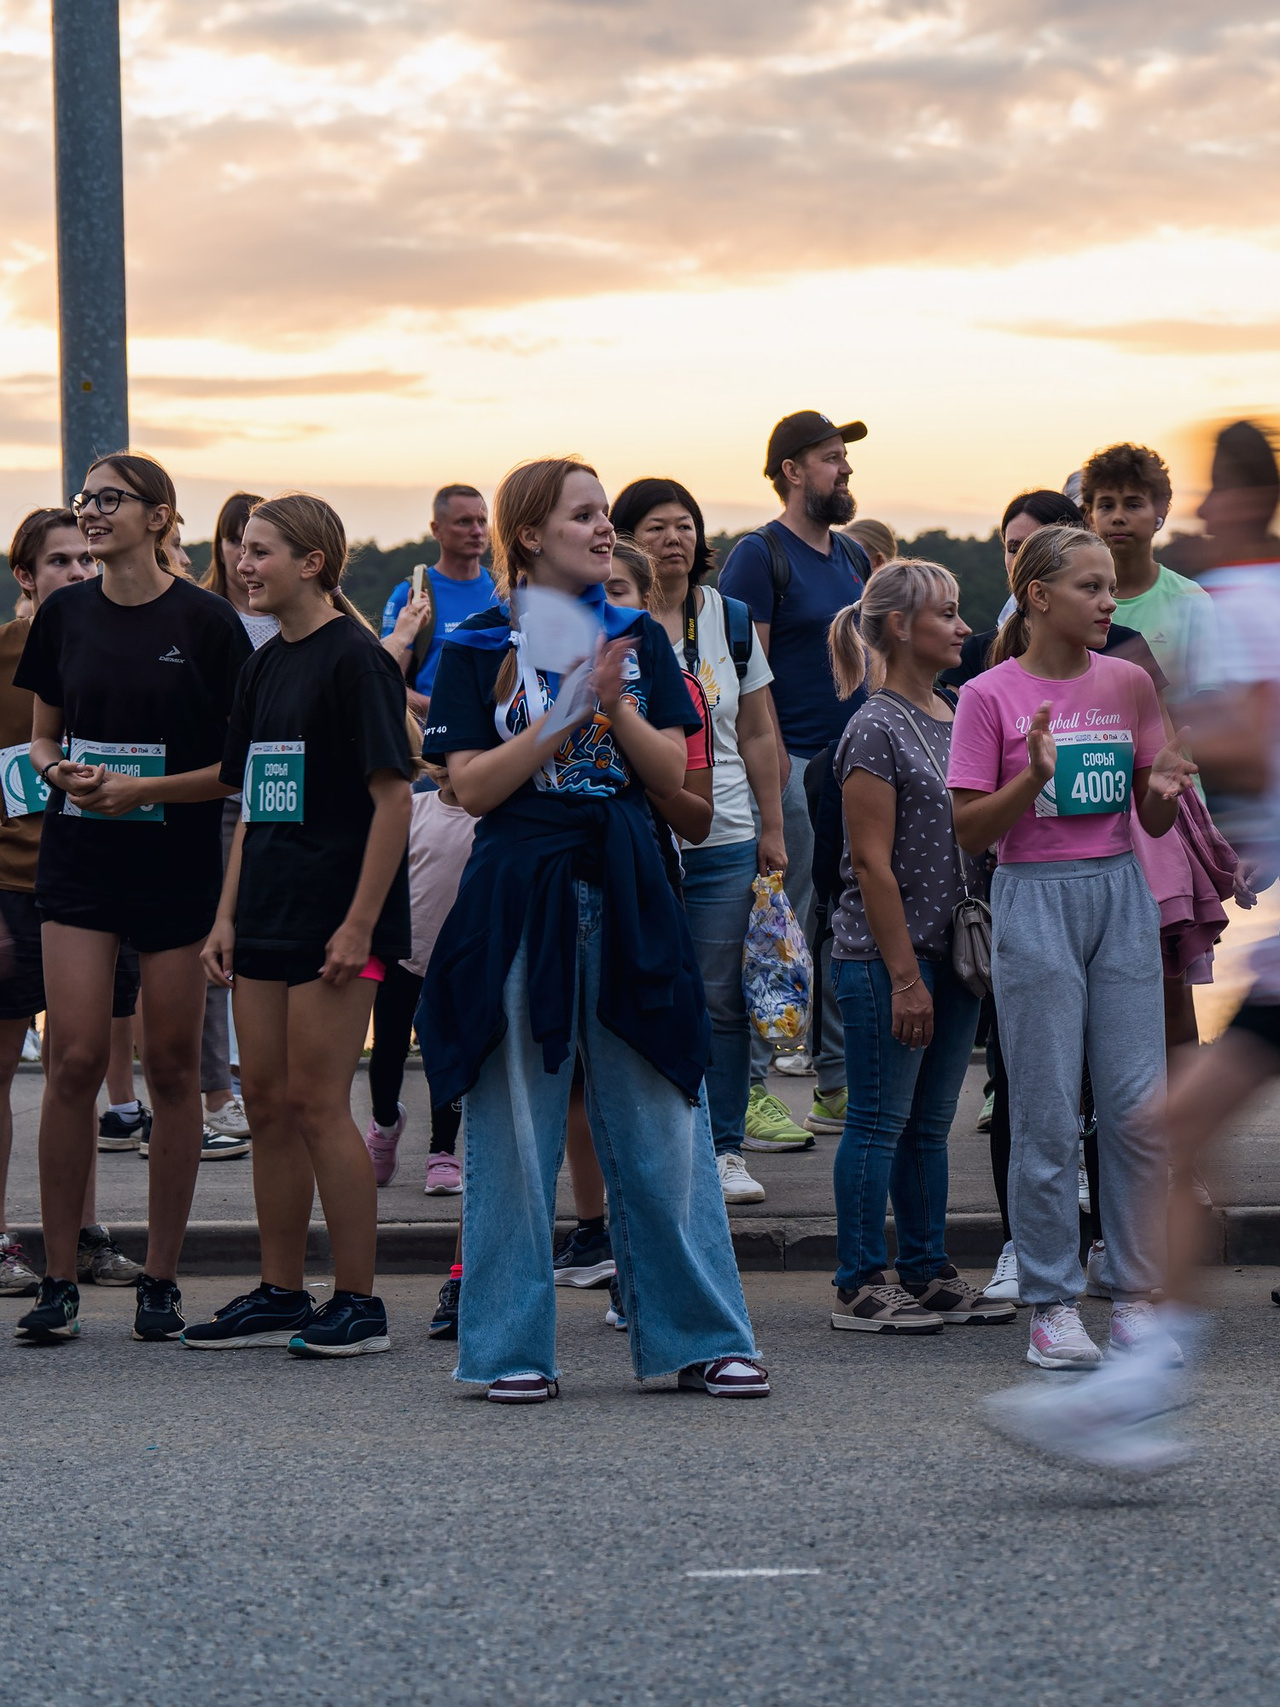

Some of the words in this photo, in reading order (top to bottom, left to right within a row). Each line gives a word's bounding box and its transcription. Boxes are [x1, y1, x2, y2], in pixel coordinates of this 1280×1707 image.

[687, 617, 695, 641] Nikon
[158, 655, 186, 664] DEMIX
[1015, 712, 1080, 735] Vyball
[1084, 708, 1121, 727] Team
[436, 725, 447, 734] 40
[1082, 752, 1115, 767] СОФЬЯ
[104, 763, 141, 777] МАРИЯ
[264, 763, 289, 776] СОФЬЯ
[1071, 770, 1127, 804] 4003
[258, 780, 298, 812] 1866
